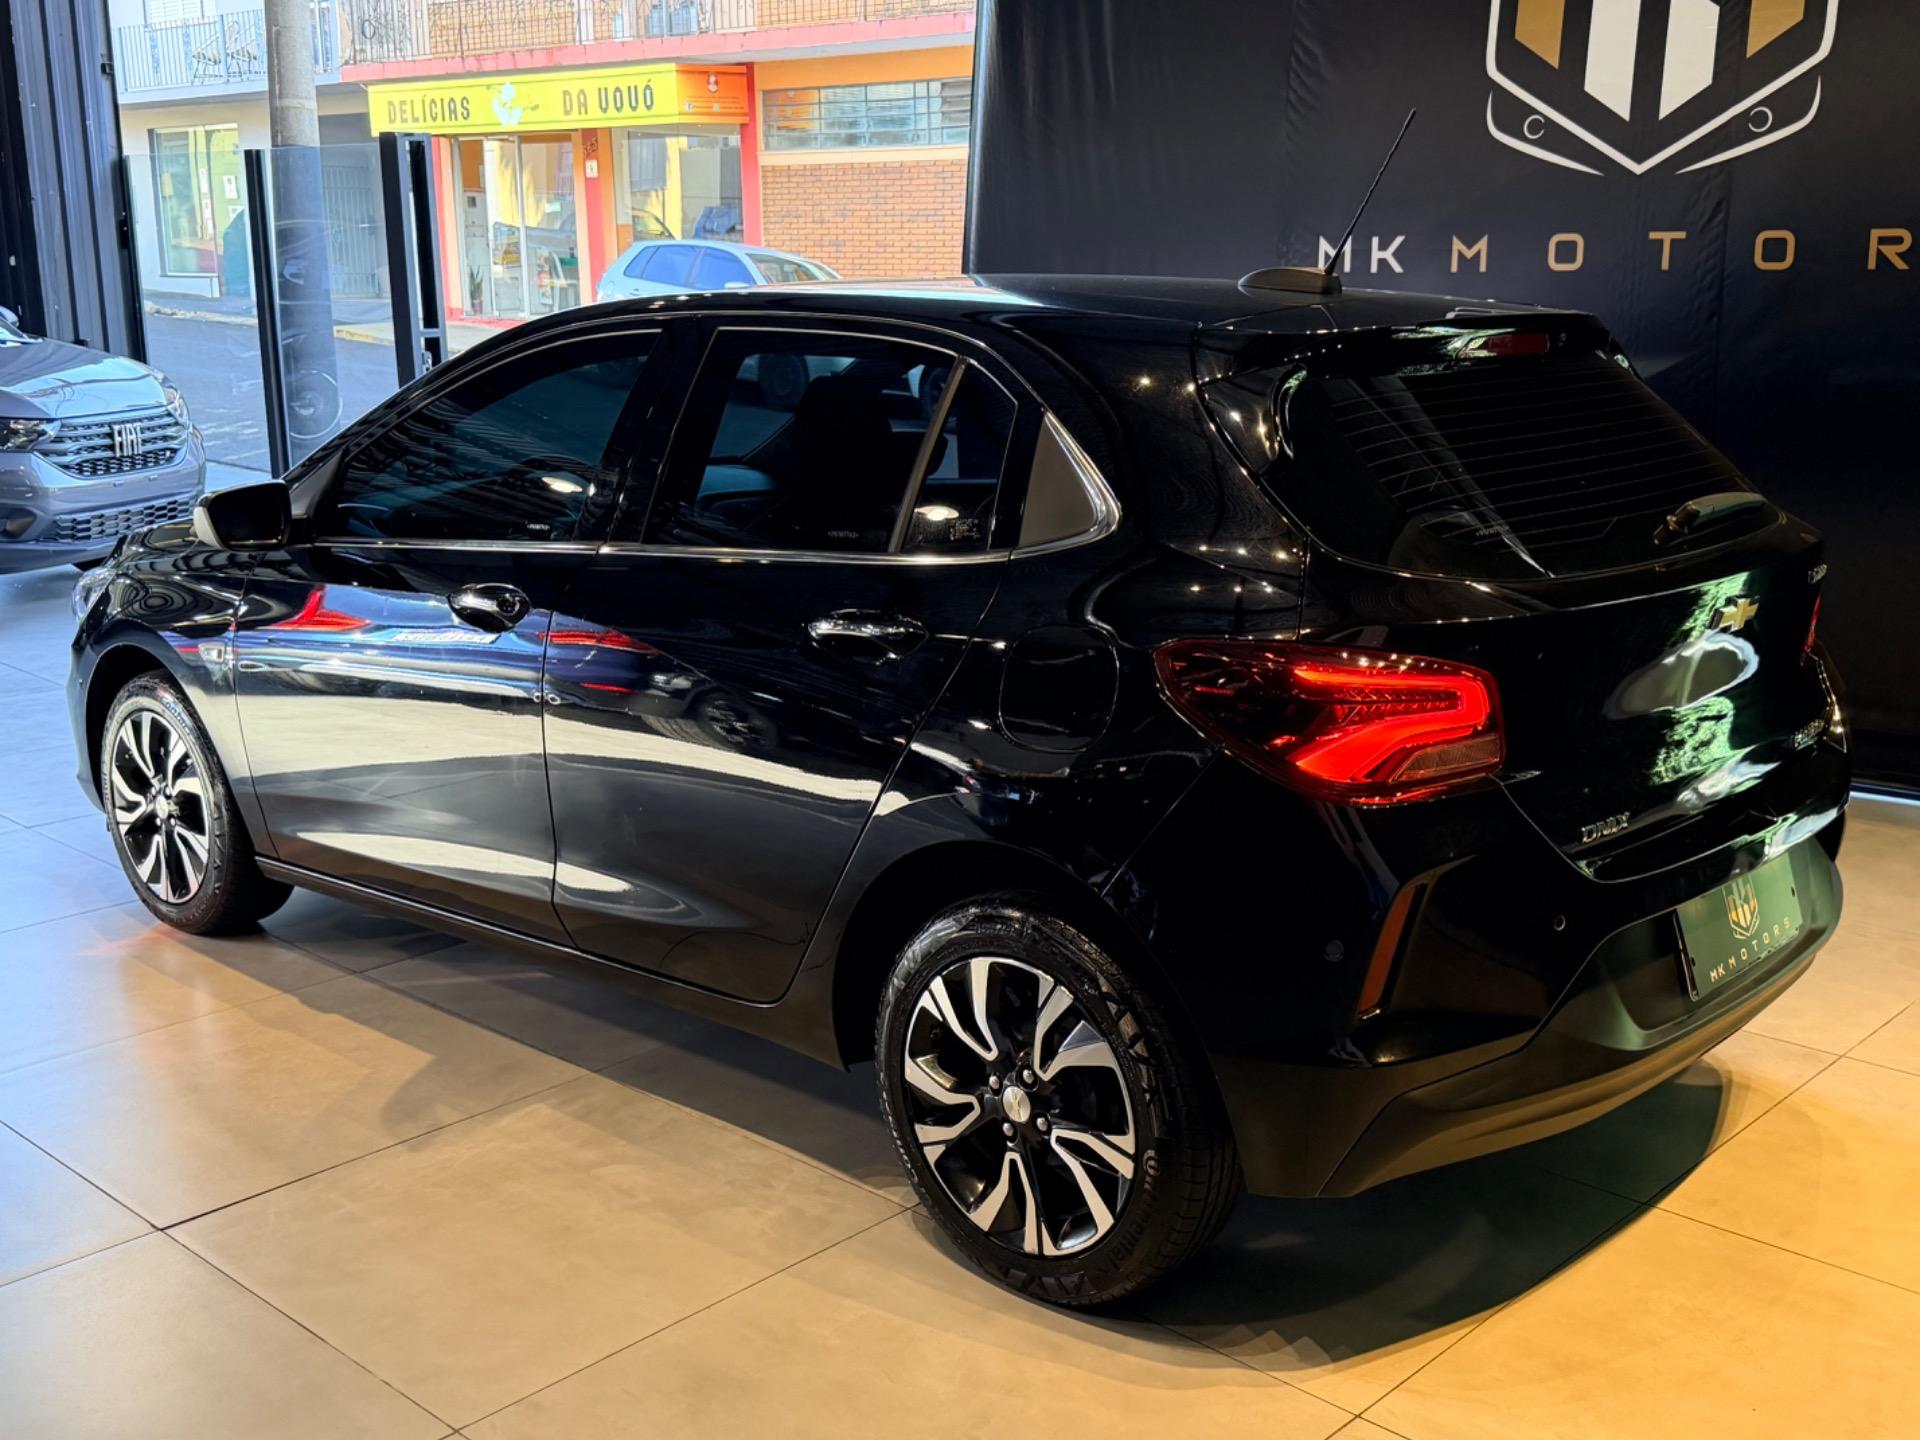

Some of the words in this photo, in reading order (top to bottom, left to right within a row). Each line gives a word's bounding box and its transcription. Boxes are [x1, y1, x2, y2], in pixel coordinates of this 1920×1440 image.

[387, 94, 470, 124] DELÍCIAS
[562, 88, 588, 116] DA
[1318, 234, 1406, 274] MK
[111, 422, 144, 458] FIAT
[1709, 962, 1726, 984] MK
[1728, 916, 1790, 969] MOTORS
